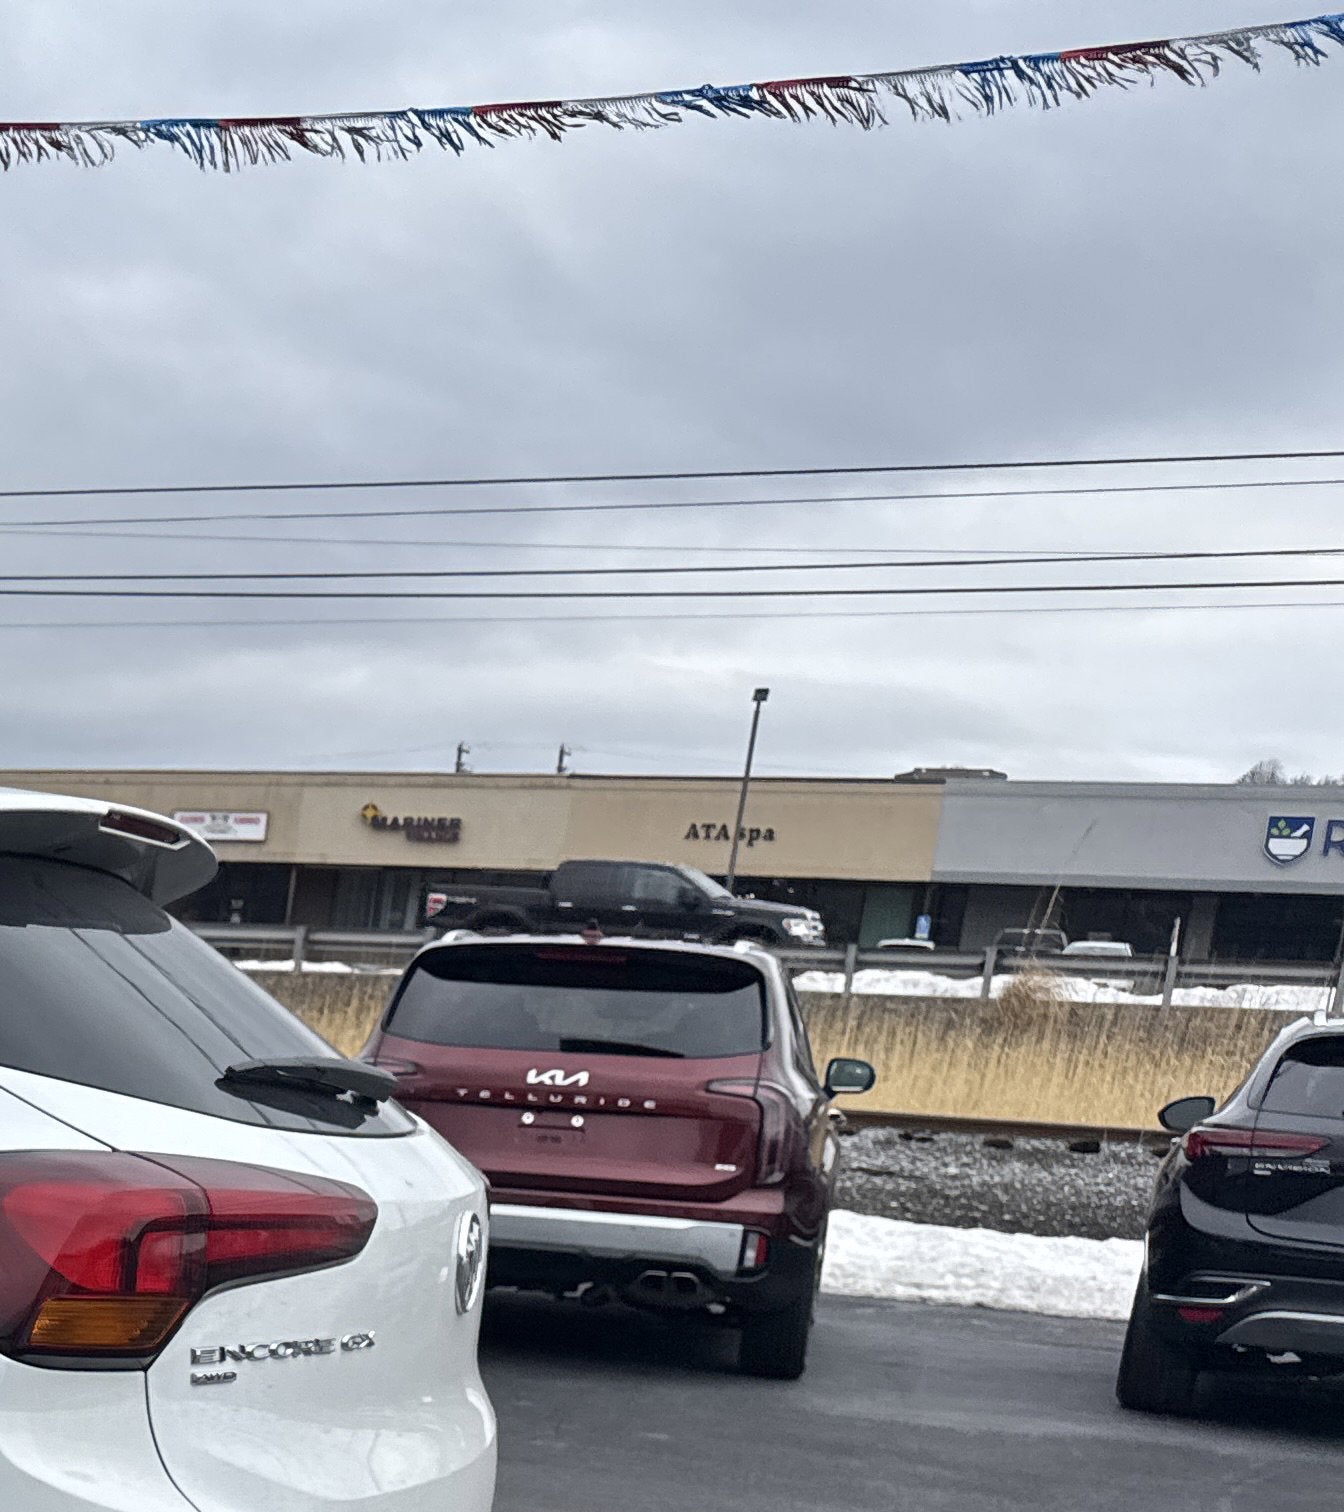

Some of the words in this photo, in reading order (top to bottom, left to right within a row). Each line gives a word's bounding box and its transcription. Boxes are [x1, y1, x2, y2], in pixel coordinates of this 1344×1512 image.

[370, 815, 463, 832] MARINER
[684, 823, 730, 840] ATA
[456, 1087, 657, 1110] TELLURIDE
[190, 1337, 336, 1366] ENCORE
[340, 1330, 376, 1351] GX
